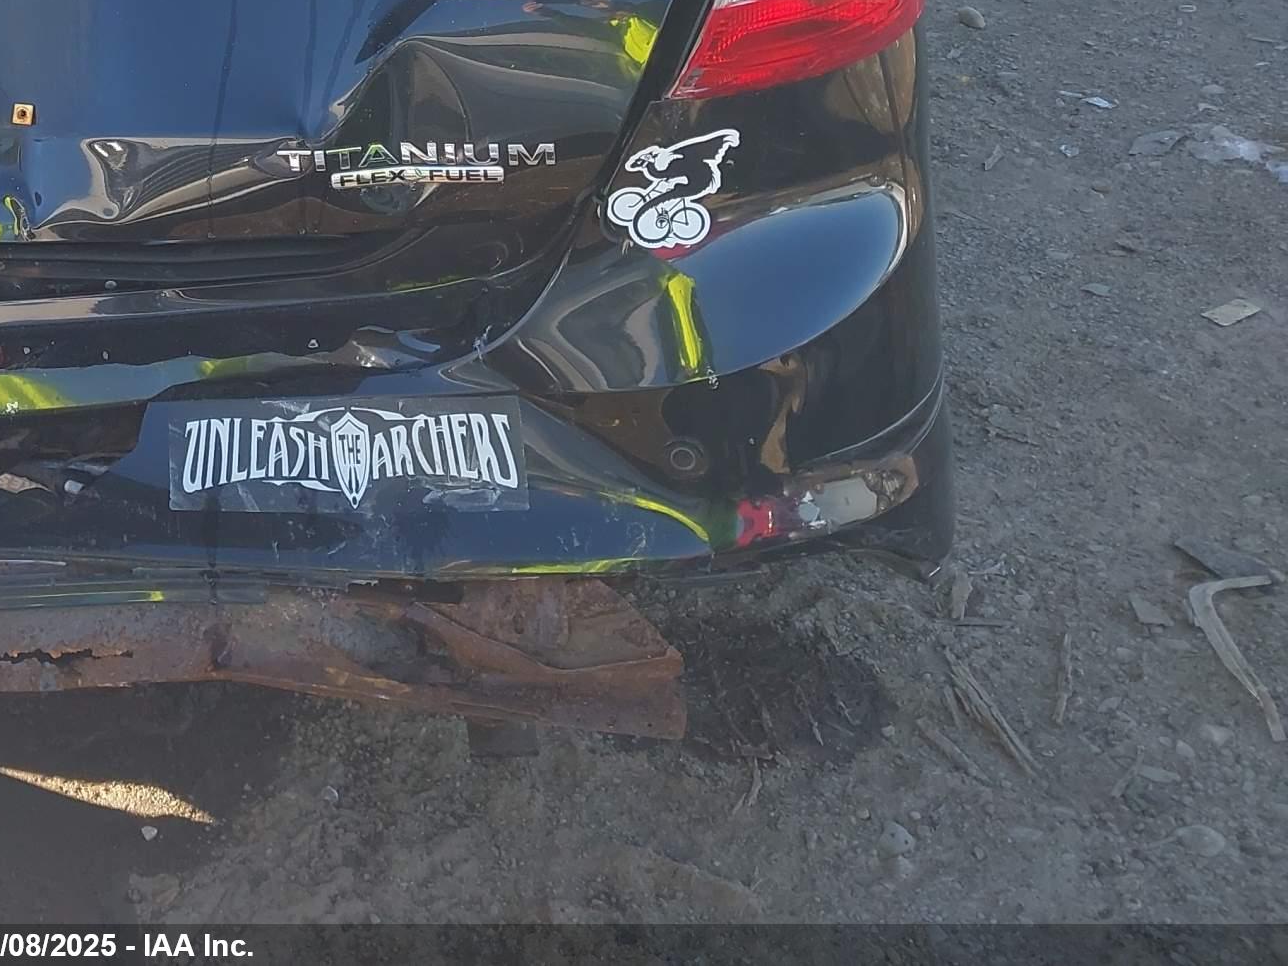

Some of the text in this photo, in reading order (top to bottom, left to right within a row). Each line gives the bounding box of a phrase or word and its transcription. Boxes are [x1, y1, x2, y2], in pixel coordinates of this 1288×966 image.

[276, 141, 557, 172] TITANIUM
[339, 169, 501, 187] FLEX FUEL
[183, 413, 518, 493] UNLEASH THE ARCHERS
